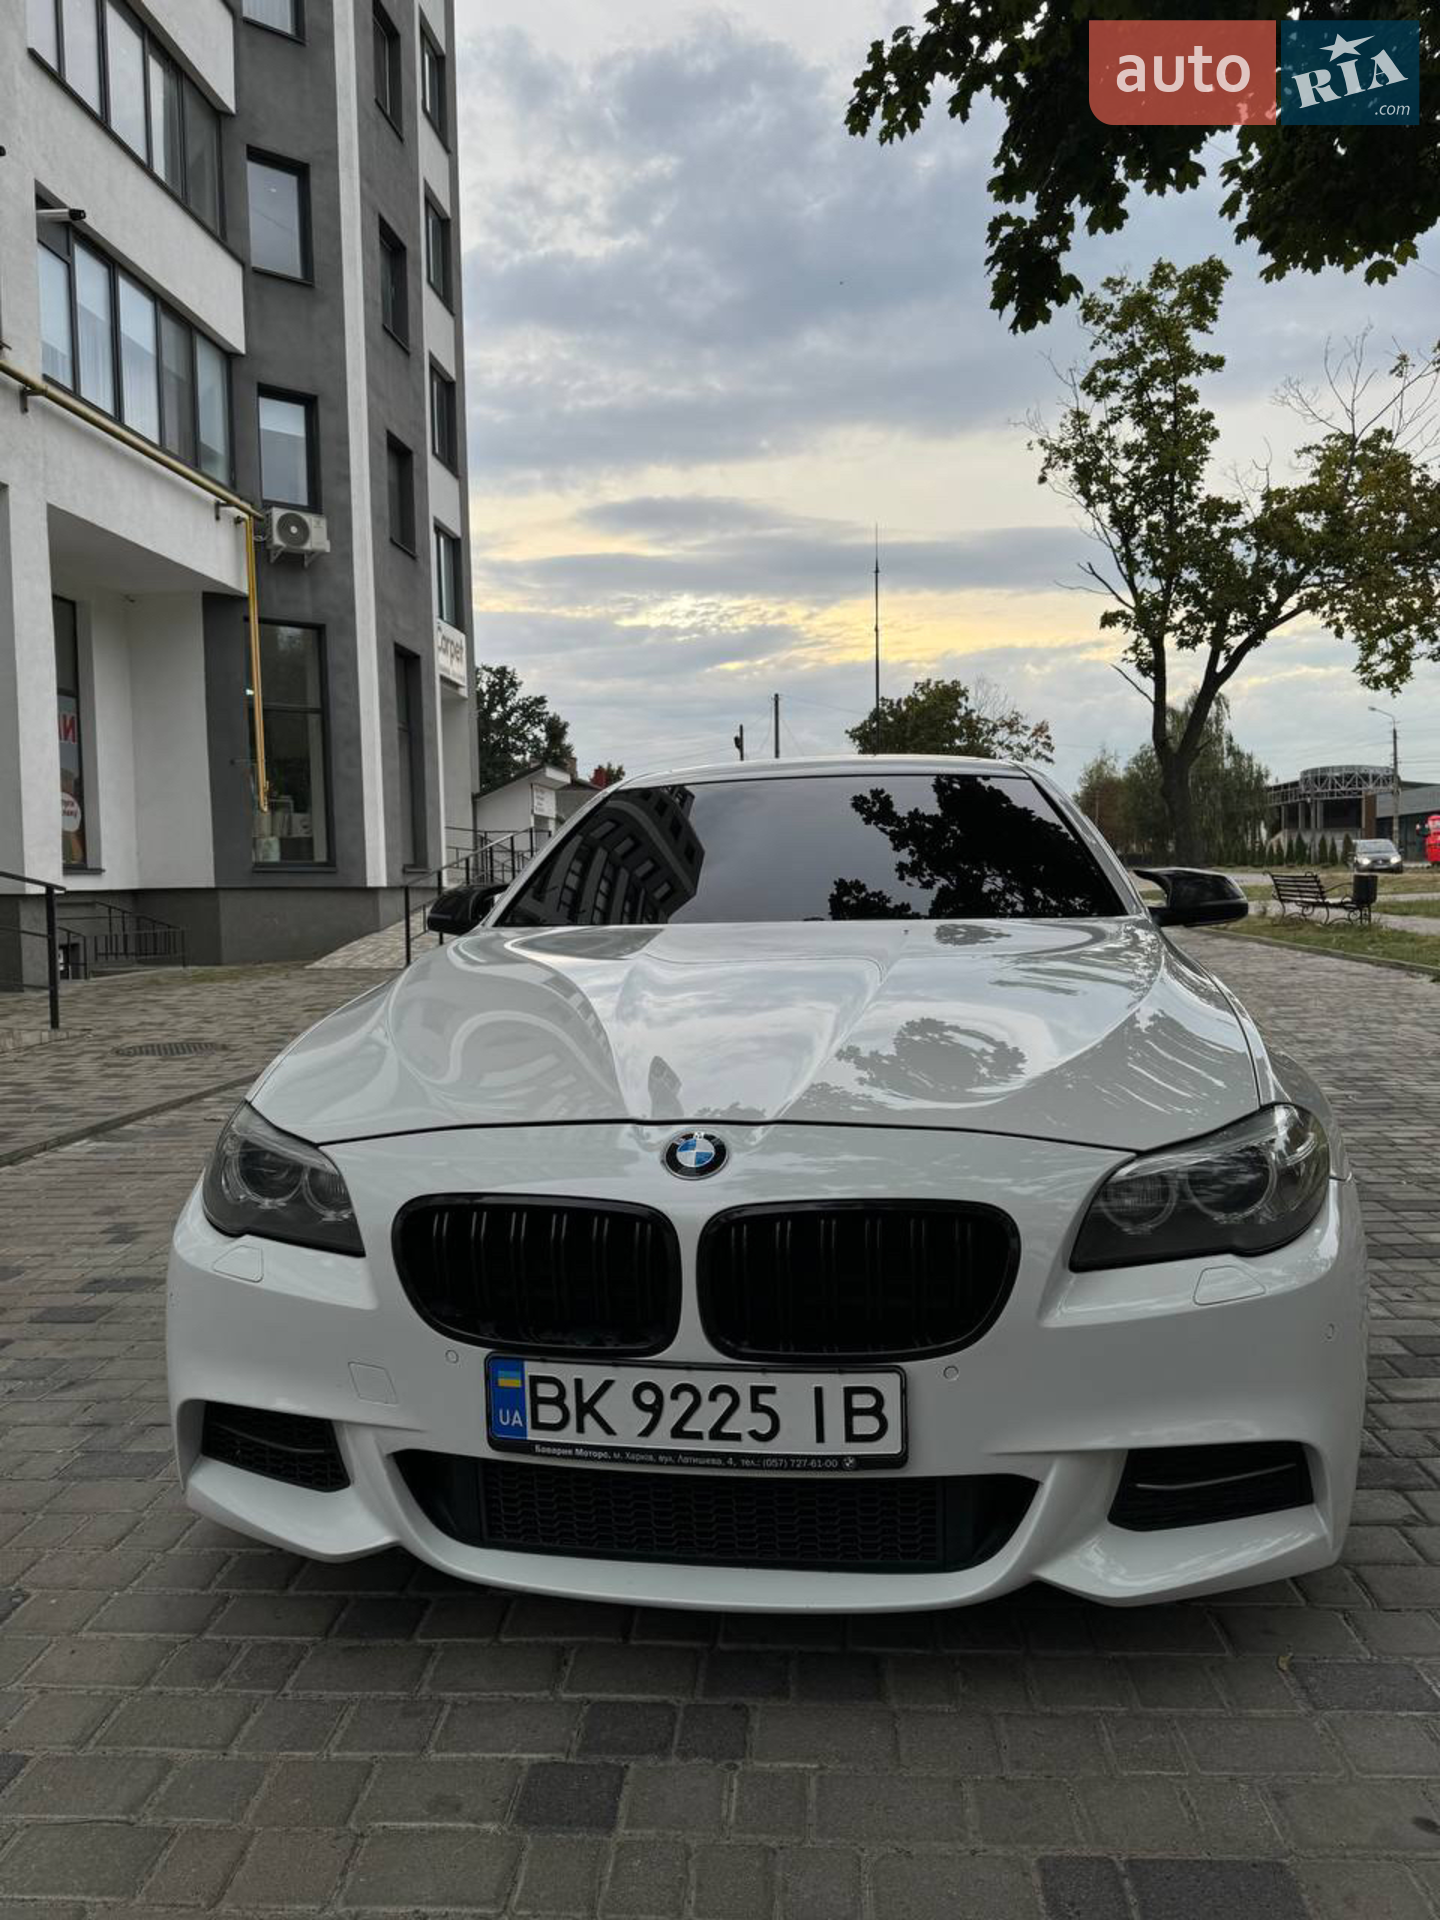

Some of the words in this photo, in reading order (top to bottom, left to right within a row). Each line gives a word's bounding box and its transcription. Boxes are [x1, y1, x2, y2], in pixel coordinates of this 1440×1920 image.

[437, 625, 464, 666] Carpet
[499, 1409, 524, 1427] UA
[528, 1374, 618, 1436] BK
[632, 1381, 781, 1443] 9225
[813, 1386, 889, 1443] IB
[763, 1457, 788, 1469] (057)
[789, 1458, 839, 1469] 727-61-00
